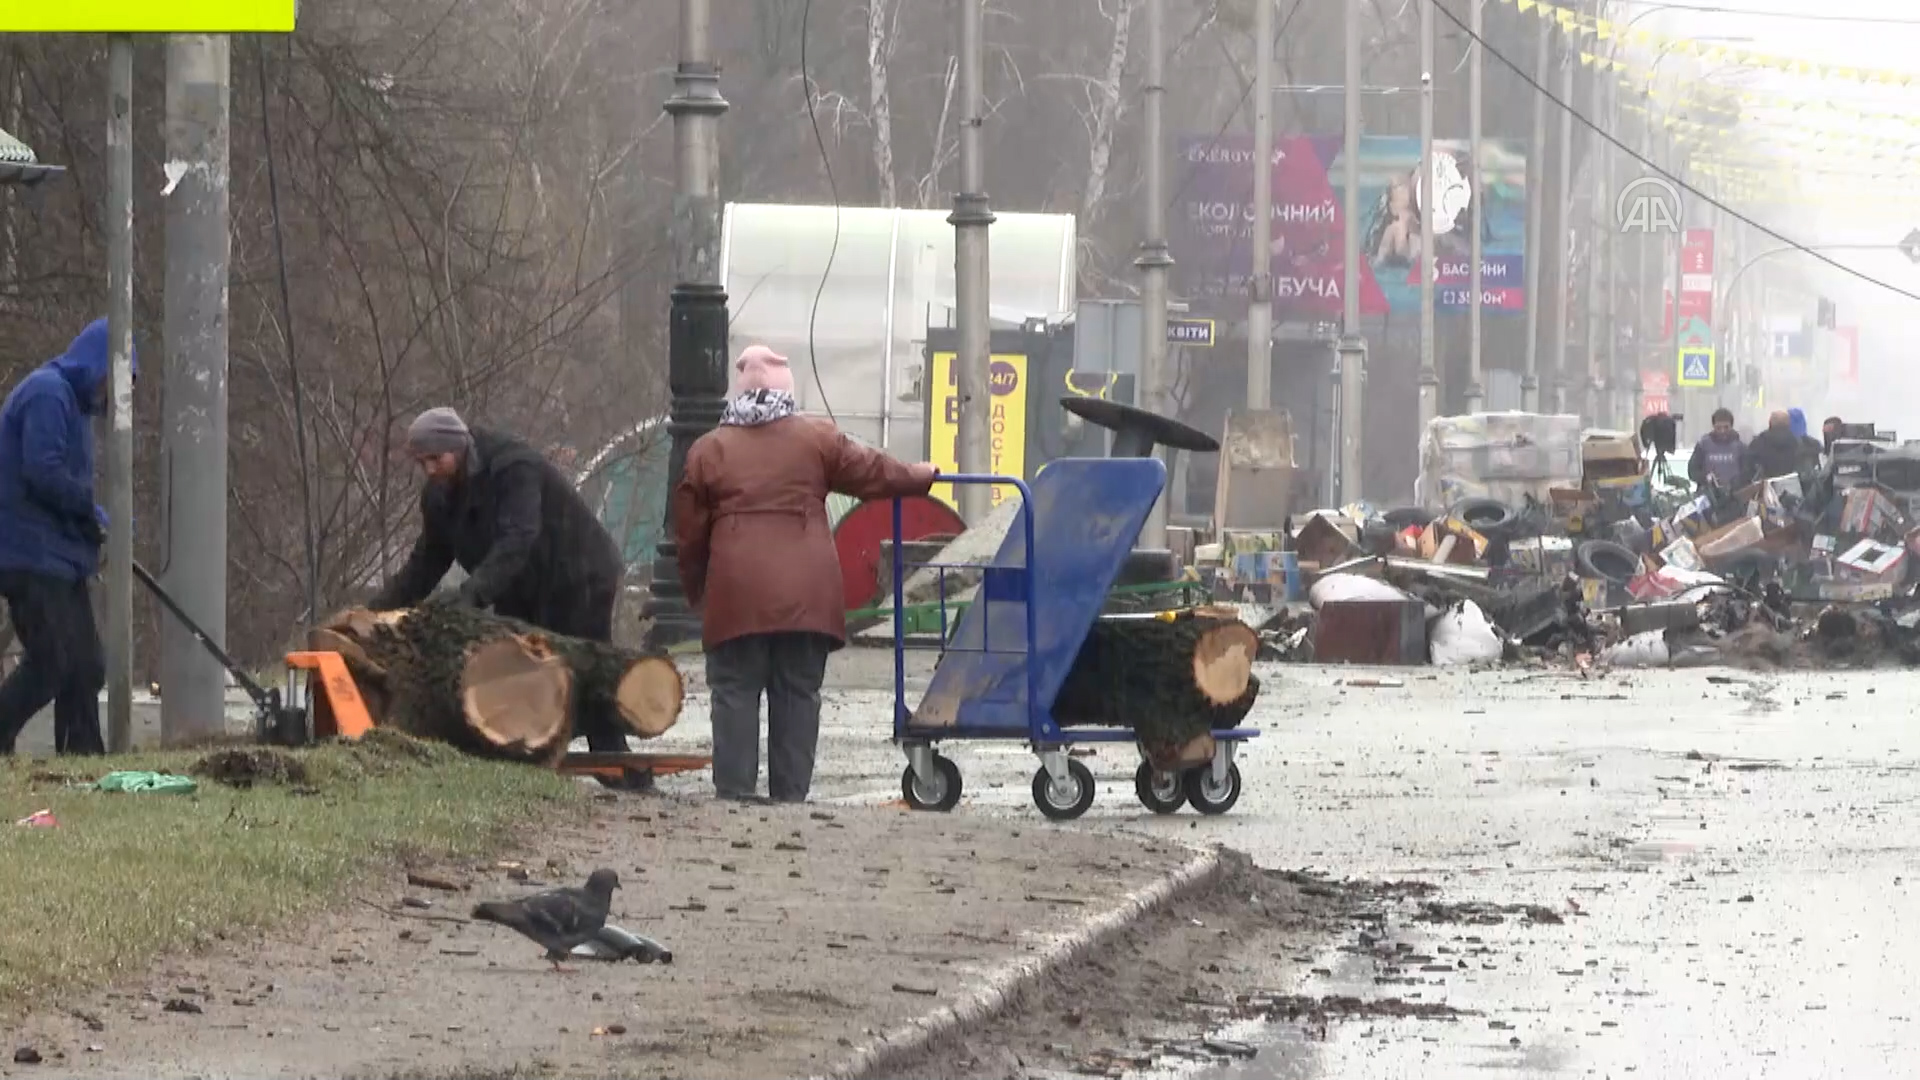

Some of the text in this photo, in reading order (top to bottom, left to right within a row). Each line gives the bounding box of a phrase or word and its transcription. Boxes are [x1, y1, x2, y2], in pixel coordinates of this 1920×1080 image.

[1442, 261, 1507, 276] БАСЙНИ
[1278, 276, 1340, 297] БУЧА
[1167, 327, 1209, 339] КВІТИ
[990, 404, 1005, 500] ДОСТВ
